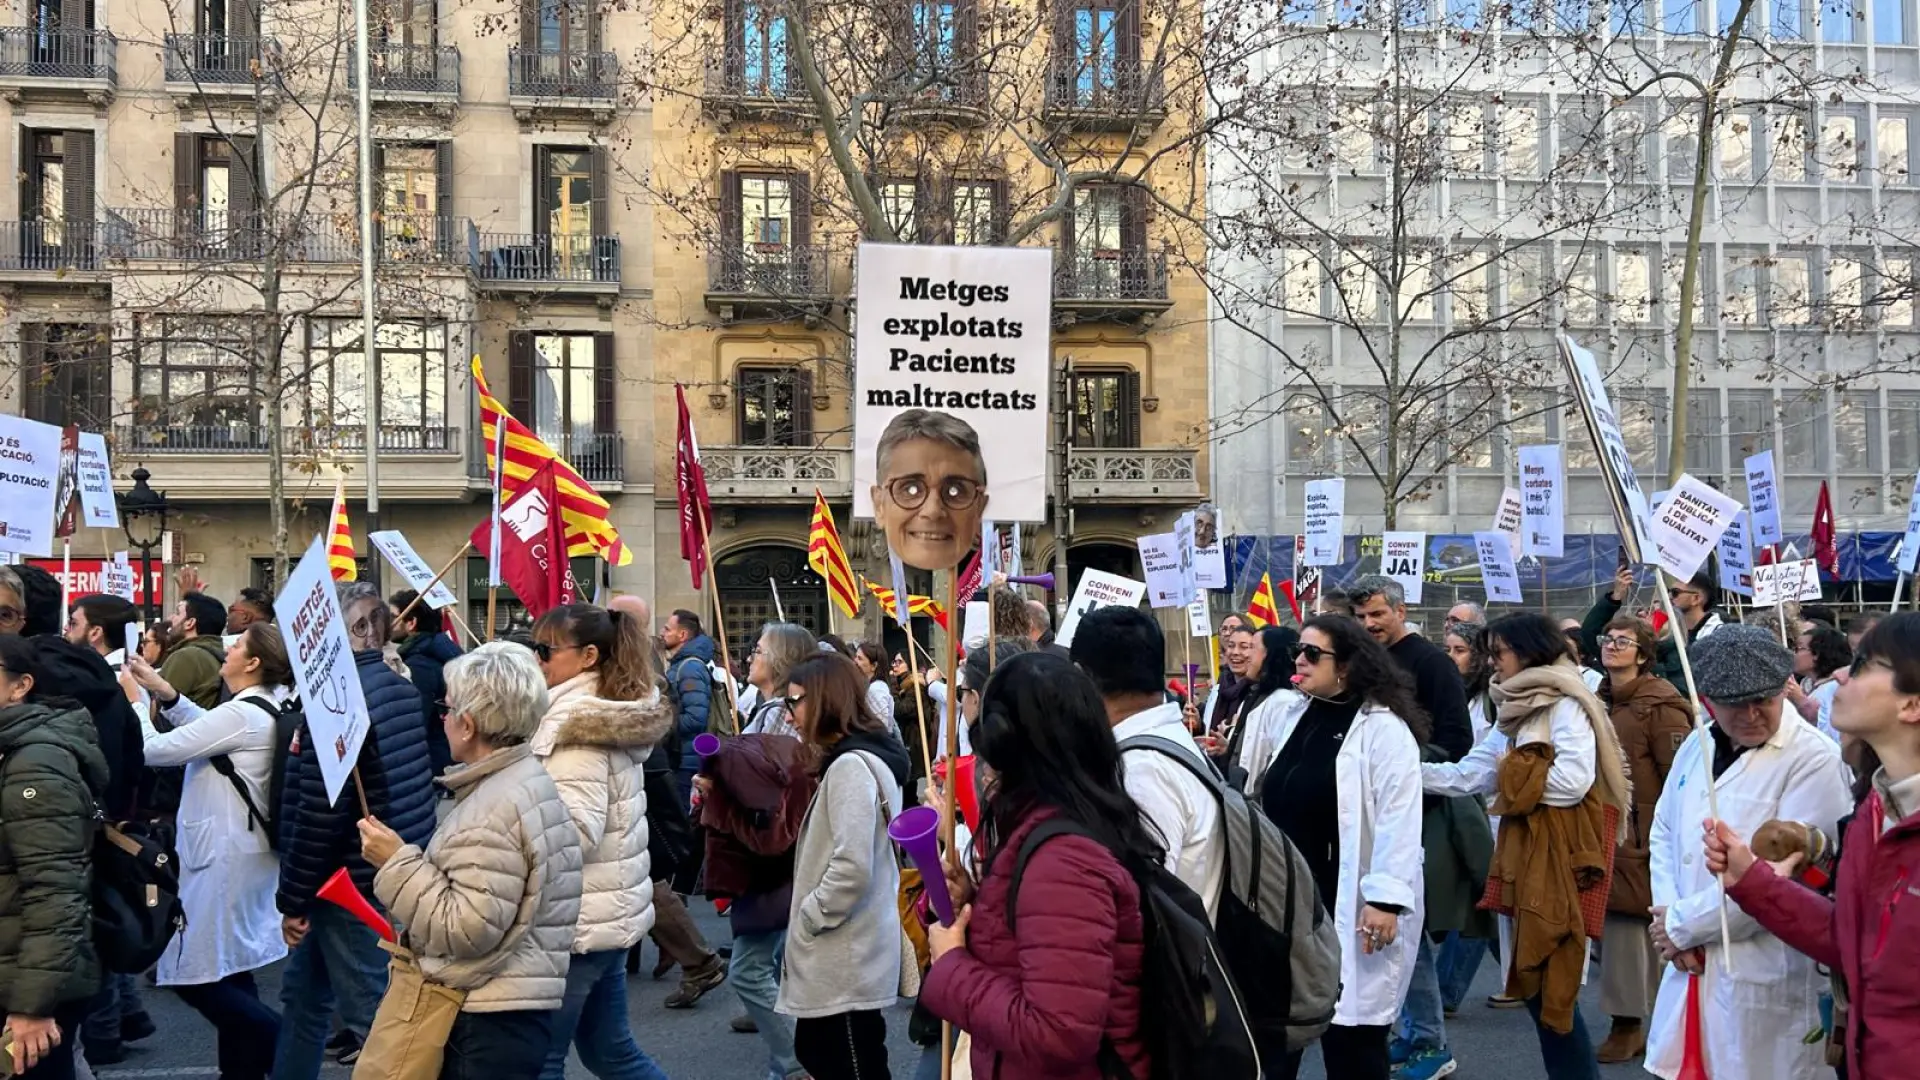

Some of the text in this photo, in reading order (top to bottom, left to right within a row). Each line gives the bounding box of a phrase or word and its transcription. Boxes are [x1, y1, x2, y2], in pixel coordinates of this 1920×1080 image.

[899, 276, 1009, 307] Metges
[883, 312, 1023, 342] explotats
[889, 348, 1016, 375] Pacients
[866, 383, 1036, 410] maltractats
[6, 436, 20, 448] ÉS
[1673, 510, 1688, 523] DE
[1680, 490, 1720, 518] SANITAT,
[1387, 541, 1419, 549] CONVENI
[1662, 516, 1708, 546] QUALITAT
[1386, 558, 1418, 576] JA!
[1087, 580, 1133, 598] CONVENI
[291, 580, 326, 643] METGE
[299, 597, 336, 664] CANSAT,
[304, 637, 330, 684] PACIENT
[308, 635, 343, 701] MALTRACTAT
